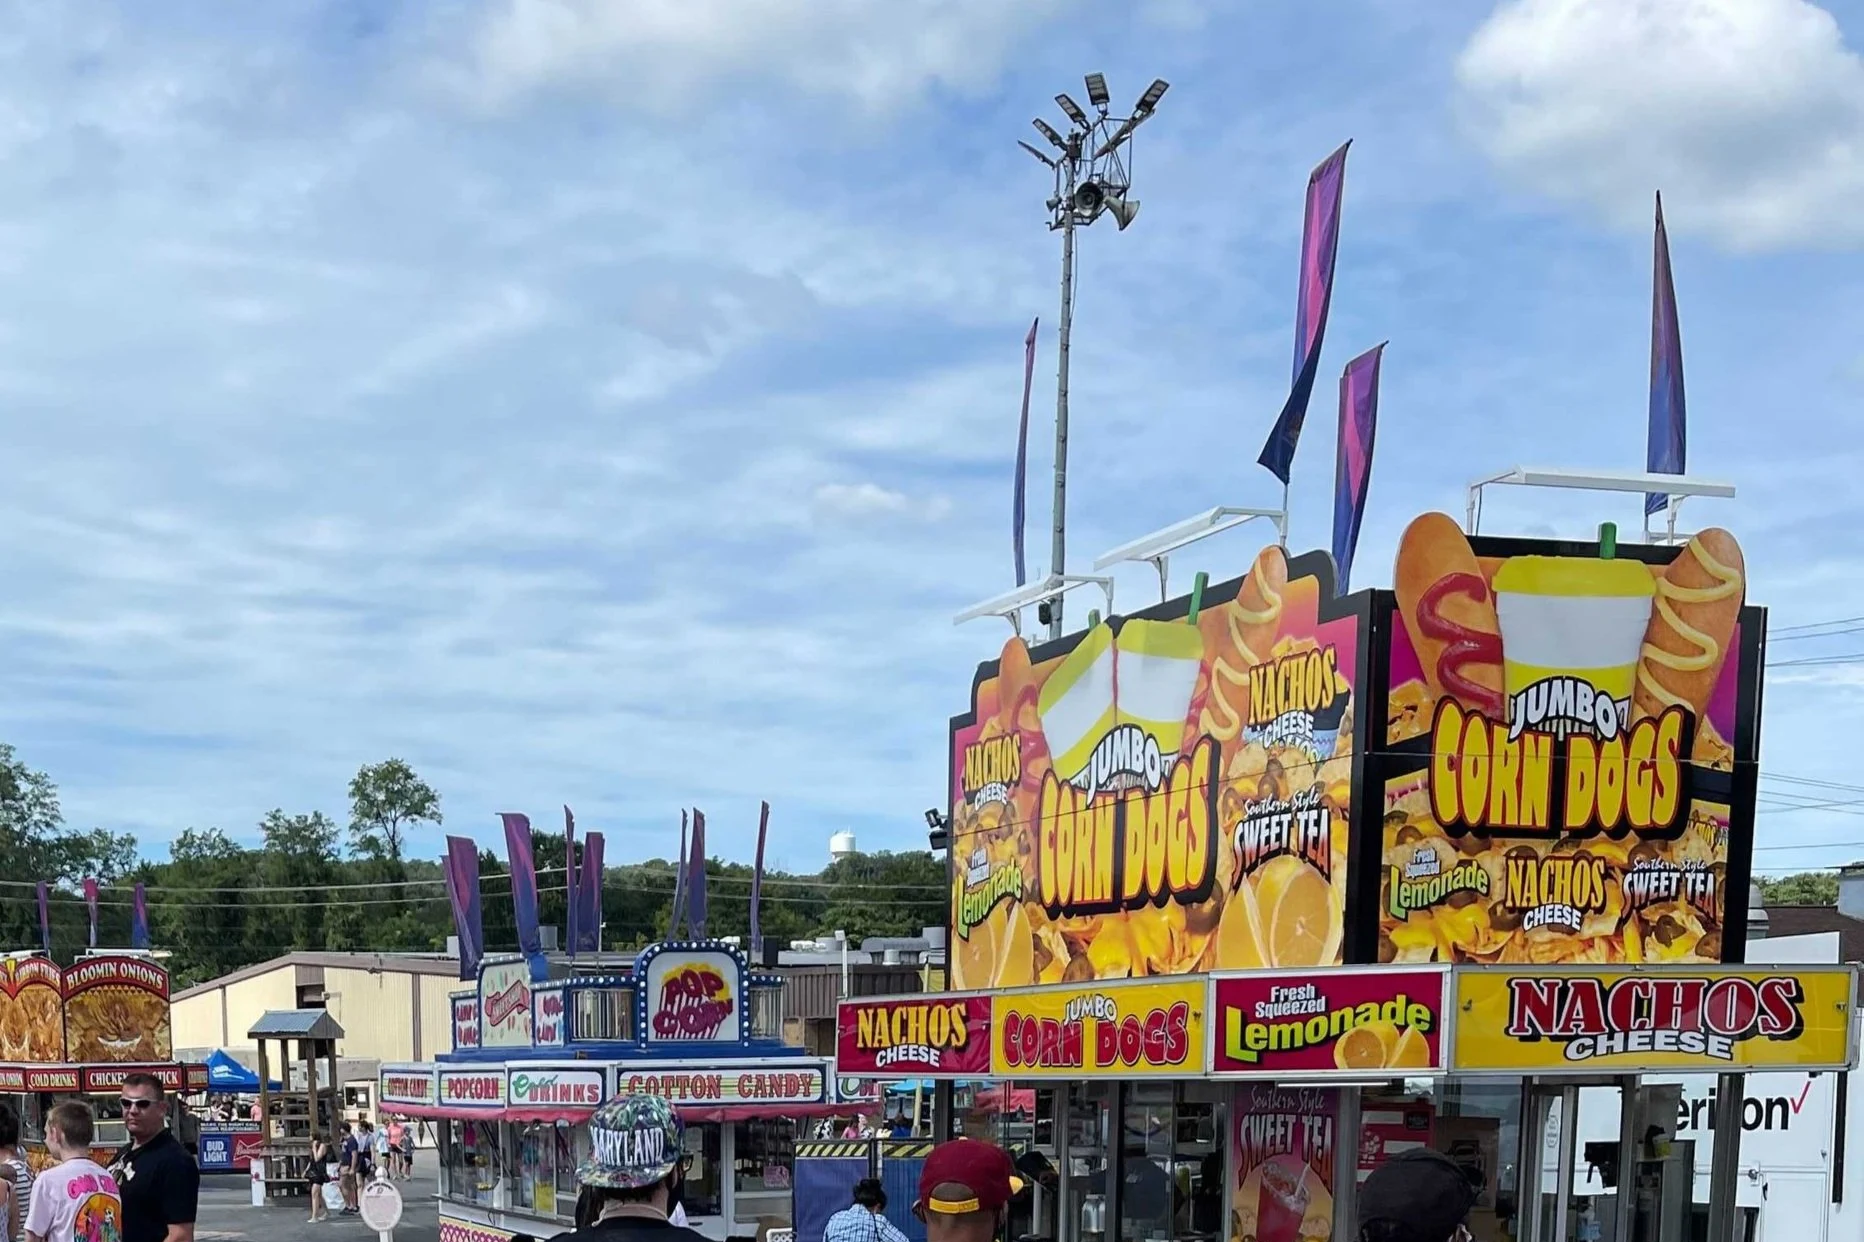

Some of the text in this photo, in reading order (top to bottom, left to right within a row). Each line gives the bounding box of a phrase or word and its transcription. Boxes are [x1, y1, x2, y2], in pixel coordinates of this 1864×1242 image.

[1249, 644, 1336, 725] NACHOS
[1510, 678, 1617, 741] JUMBO
[1264, 710, 1314, 750] CHEESE
[965, 733, 1020, 792] NACHOS
[1086, 725, 1161, 808] JUMBO
[1432, 699, 1686, 827] CORN DOGS
[975, 783, 1008, 810] CHEESE
[1244, 786, 1320, 818] Southern Style
[1040, 738, 1212, 906] CORN DOGS
[1232, 808, 1331, 887] SWEET TEA
[1633, 856, 1706, 872] Southern Style
[957, 858, 1023, 938] Lemonade
[1390, 860, 1488, 919] Lemonade
[1505, 858, 1604, 908] NACHOS
[1622, 872, 1714, 919] SWEET TEA
[1523, 904, 1581, 931] CHEESE
[66, 962, 163, 989] BLOOMIN ONIONS
[663, 969, 724, 1005] POP
[1271, 983, 1315, 1003] Fresh
[857, 1002, 966, 1048] NACHOS
[1064, 994, 1118, 1025] JUMBO
[1255, 996, 1325, 1018] Squeezed
[1508, 977, 1799, 1036] NACHOS
[1004, 1002, 1188, 1067] CORN DOGS
[1226, 994, 1431, 1062] Lemonade
[1565, 1029, 1733, 1060] CHEESE
[876, 1044, 940, 1068] CHEESE
[30, 1073, 76, 1087] COLD DRINKS
[448, 1077, 499, 1098] POPCORN
[528, 1083, 599, 1102] DRINKS
[629, 1074, 722, 1099] COTTON
[738, 1074, 814, 1098] CANDY
[1298, 1085, 1324, 1117] Style
[1676, 1088, 1789, 1131] erion
[203, 1151, 228, 1162] LIGHT
[206, 1140, 225, 1152] BUD
[590, 1125, 664, 1166] MARYLAND
[1239, 1114, 1333, 1196] SWEET TEA
